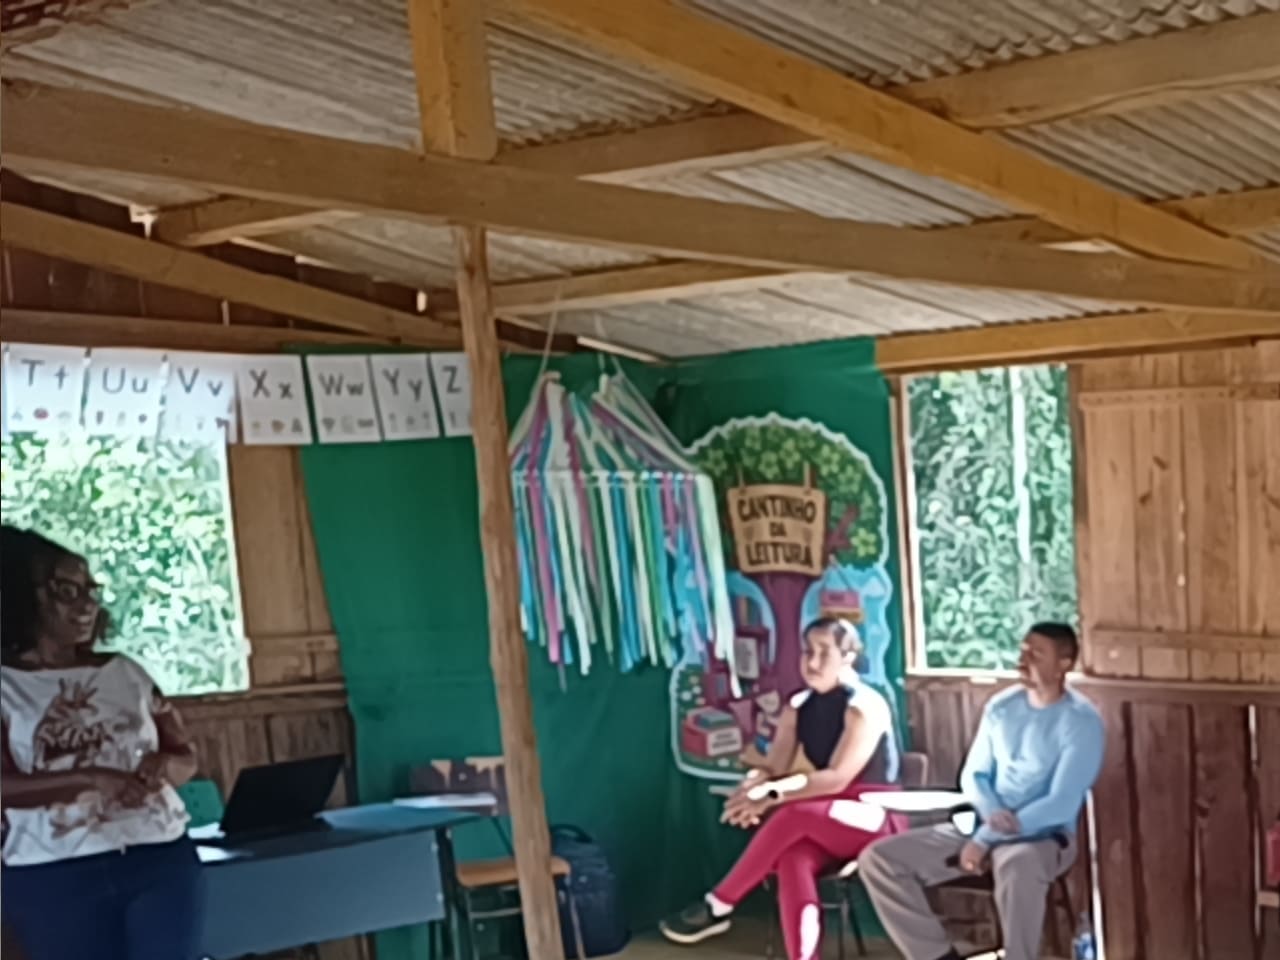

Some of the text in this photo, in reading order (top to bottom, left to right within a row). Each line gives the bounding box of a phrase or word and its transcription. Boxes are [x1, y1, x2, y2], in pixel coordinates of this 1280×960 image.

[737, 494, 817, 524] CANTINHO
[769, 521, 787, 537] DA
[745, 541, 814, 569] LEITURA
